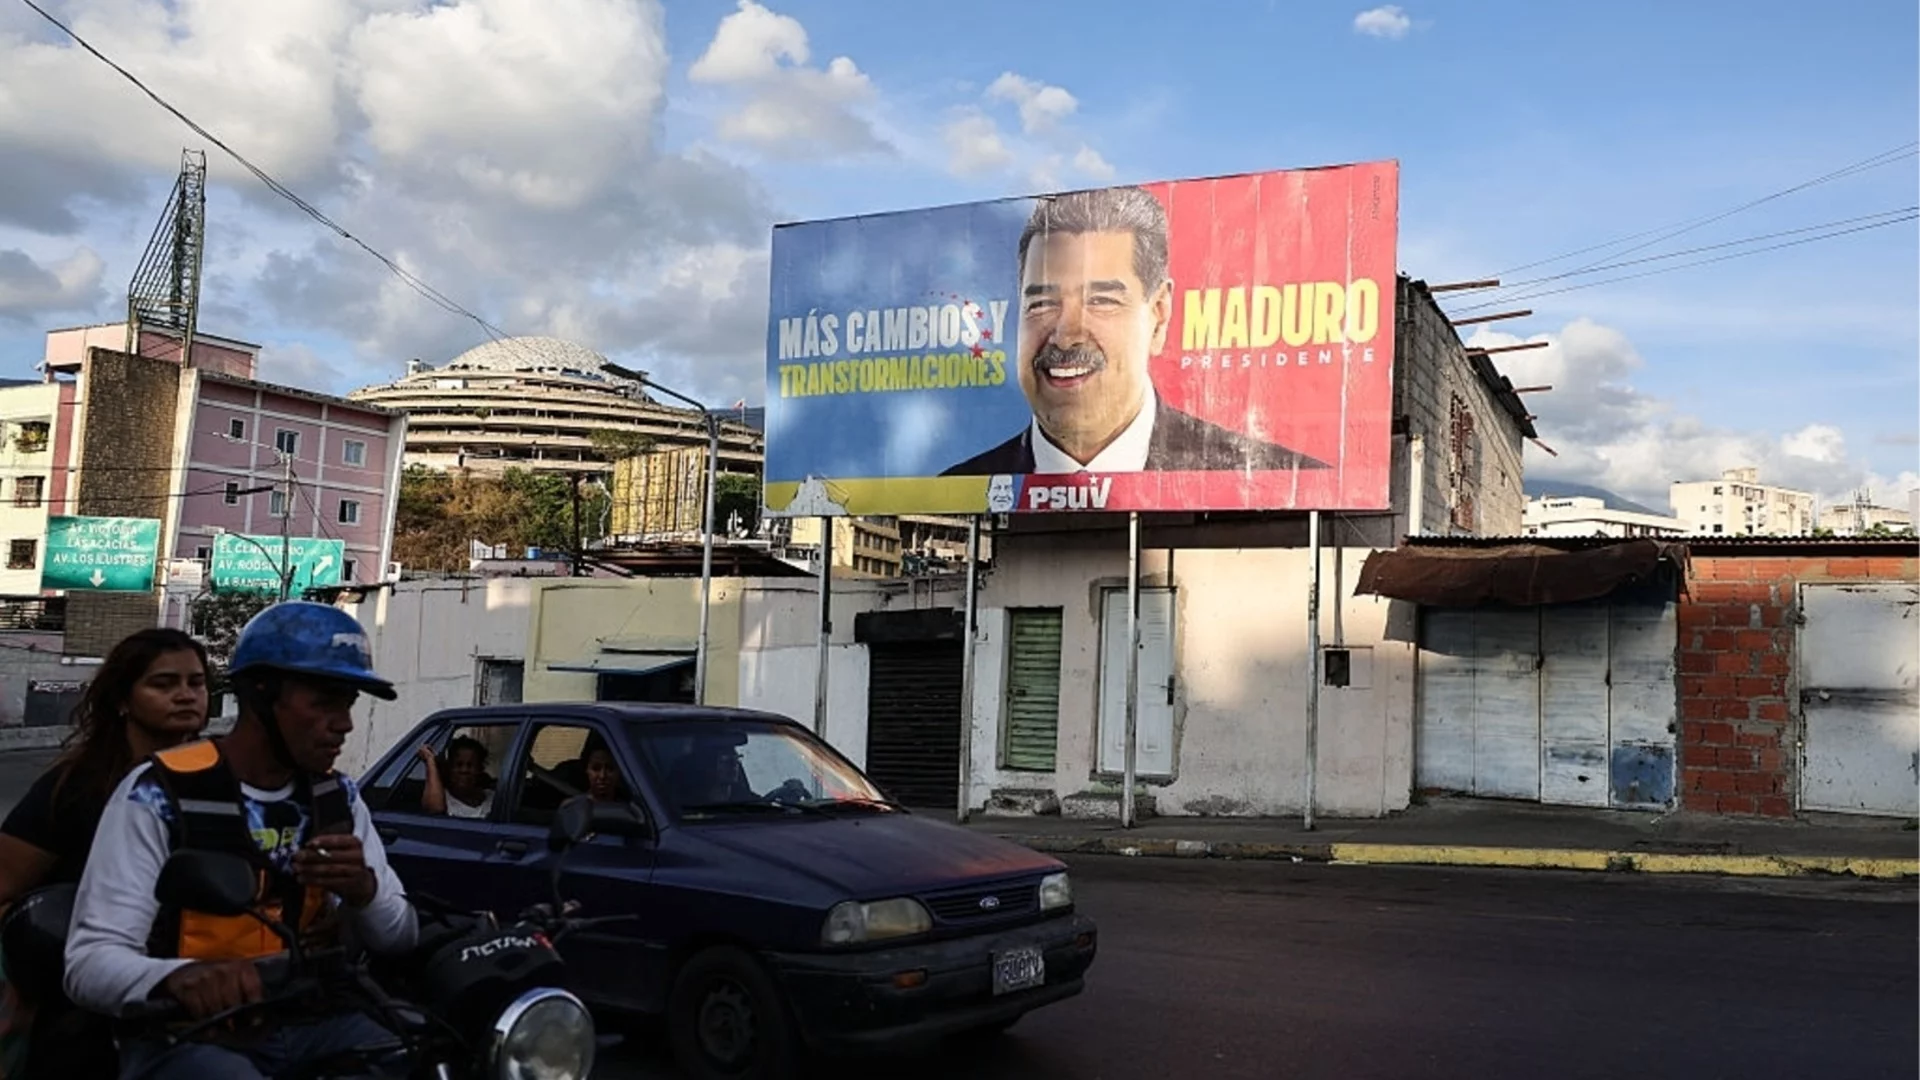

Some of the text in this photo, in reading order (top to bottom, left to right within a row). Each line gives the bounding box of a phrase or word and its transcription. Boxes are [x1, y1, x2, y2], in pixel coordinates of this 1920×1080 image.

[1182, 278, 1379, 351] MADURO
[779, 300, 1009, 360] MÁS CAMBIOS Y
[1181, 348, 1375, 369] PRESIDENTE
[779, 350, 1006, 398] TRANSFORMACIONES
[73, 553, 94, 565] LOS
[221, 544, 232, 553] EL
[216, 577, 230, 587] LA
